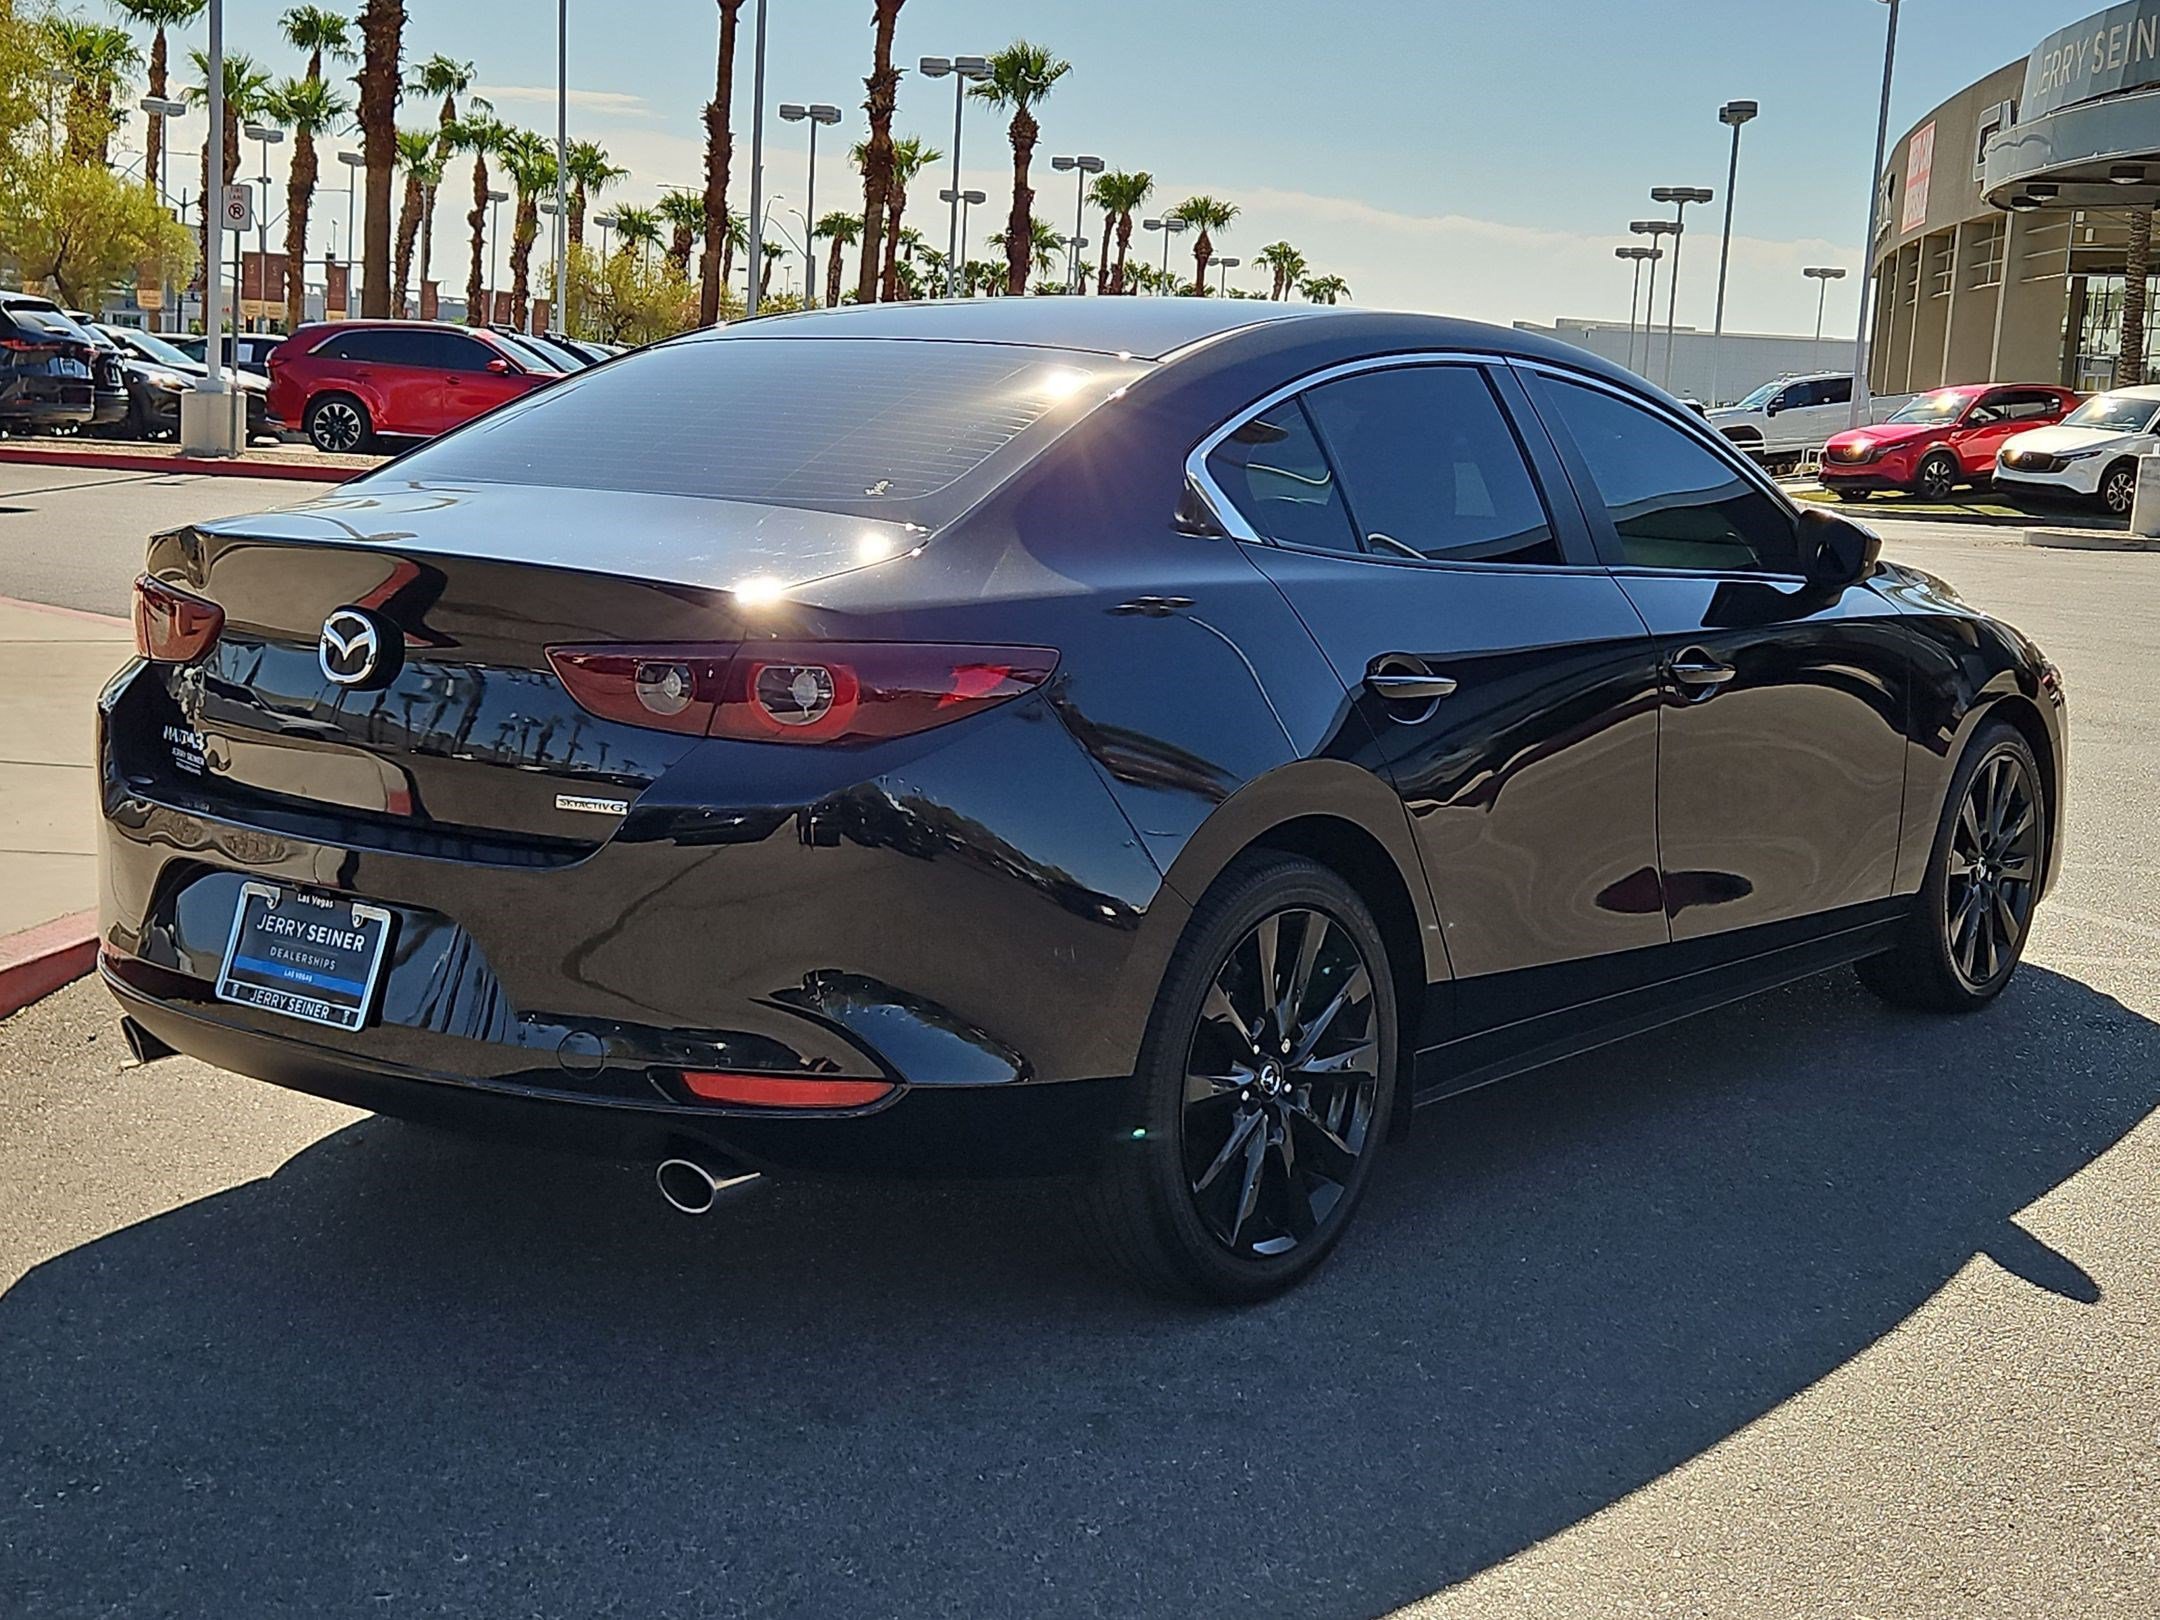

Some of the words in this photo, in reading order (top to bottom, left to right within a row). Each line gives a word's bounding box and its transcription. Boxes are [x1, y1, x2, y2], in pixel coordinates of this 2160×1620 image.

[2033, 36, 2090, 98] JERRY
[2092, 15, 2158, 74] SEIN
[297, 893, 310, 904] Las
[311, 895, 334, 908] Vegas
[257, 914, 307, 938] JERRY
[306, 924, 366, 952] SEINER
[270, 946, 336, 970] DEALERSHIPS
[284, 969, 295, 978] LAS
[249, 989, 288, 1009] JERRY
[287, 997, 330, 1020] SEINER
